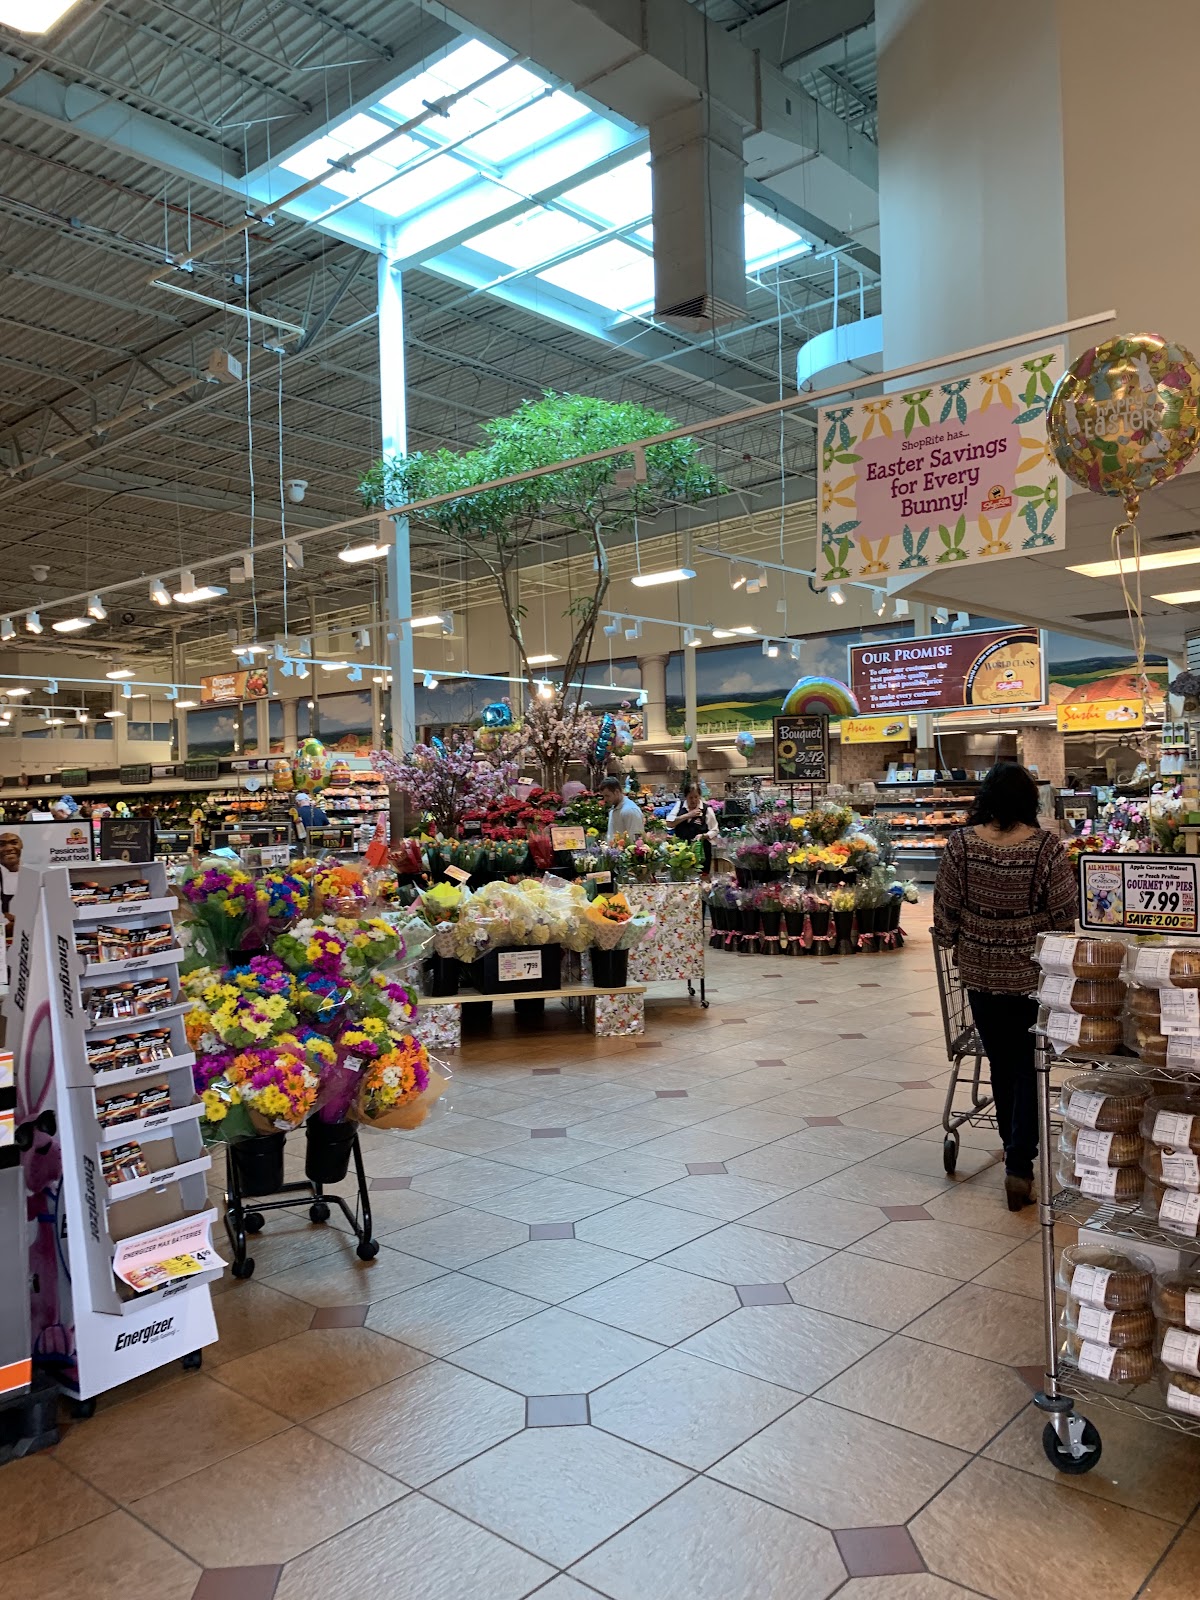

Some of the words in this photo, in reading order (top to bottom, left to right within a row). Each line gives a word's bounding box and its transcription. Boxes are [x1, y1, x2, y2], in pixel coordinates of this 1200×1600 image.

[902, 436, 944, 450] ShopRite
[947, 430, 969, 441] has...
[866, 457, 924, 481] Easter
[930, 438, 1007, 468] Savings
[891, 478, 918, 498] for
[923, 467, 980, 492] Every
[901, 486, 968, 517] Bunny!
[905, 664, 936, 672] customers
[883, 673, 907, 683] possible
[907, 671, 929, 680] quality
[901, 679, 927, 688] possible
[927, 678, 943, 686] price
[913, 690, 942, 698] customer
[876, 700, 900, 708] satisfied
[1064, 704, 1100, 721] Sushi
[848, 721, 875, 733] Asian
[779, 725, 823, 743] Bouquet
[50, 847, 89, 855] Passionate
[1127, 879, 1164, 890] GOURMET
[1165, 881, 1173, 889] 9"
[1176, 881, 1193, 891] PIES
[1139, 891, 1180, 912] $7.99
[117, 905, 142, 913] Energizer
[1127, 914, 1153, 925] SAVE
[1153, 915, 1179, 926] $2.00
[123, 960, 149, 968] Energizer
[14, 929, 30, 1012] Energizer
[57, 934, 74, 1019] Energizer
[135, 1064, 160, 1075] Energizer
[144, 1117, 169, 1127] Energizer
[150, 1172, 175, 1184] Energizer
[83, 1154, 100, 1243] Energizer
[123, 1245, 157, 1260] ENERGIZER
[171, 1229, 202, 1244] BATTERIES
[162, 1283, 188, 1298] Energizer
[114, 1316, 175, 1352] Energizer
